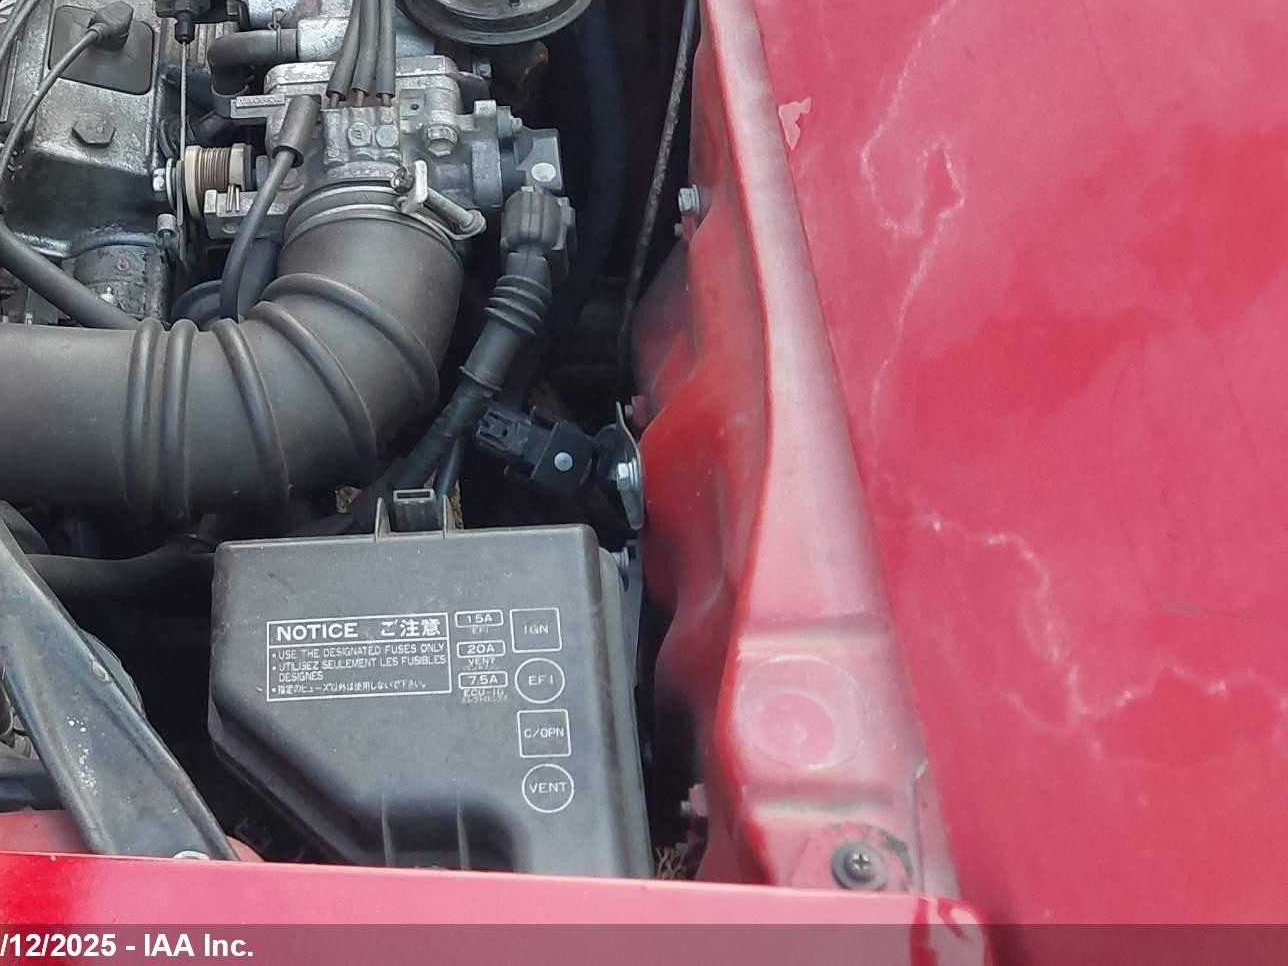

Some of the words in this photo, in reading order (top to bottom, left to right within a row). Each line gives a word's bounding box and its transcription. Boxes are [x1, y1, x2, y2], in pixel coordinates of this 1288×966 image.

[466, 614, 492, 624] 15A
[277, 622, 358, 641] NOTICE
[380, 618, 440, 637] ご注意
[524, 624, 549, 634] IGN
[279, 649, 297, 660] USE
[301, 648, 320, 659] THE
[323, 645, 381, 658] DESIGNATED
[384, 644, 416, 654] FUSES
[420, 643, 444, 653] ONLY
[467, 643, 495, 654] 20A
[380, 656, 398, 667] LES
[401, 654, 446, 666] FUSIBLES
[279, 670, 324, 682] DESIGNES
[528, 674, 553, 685] EFI
[524, 727, 564, 738] C/OPN
[529, 782, 568, 794] VENT
